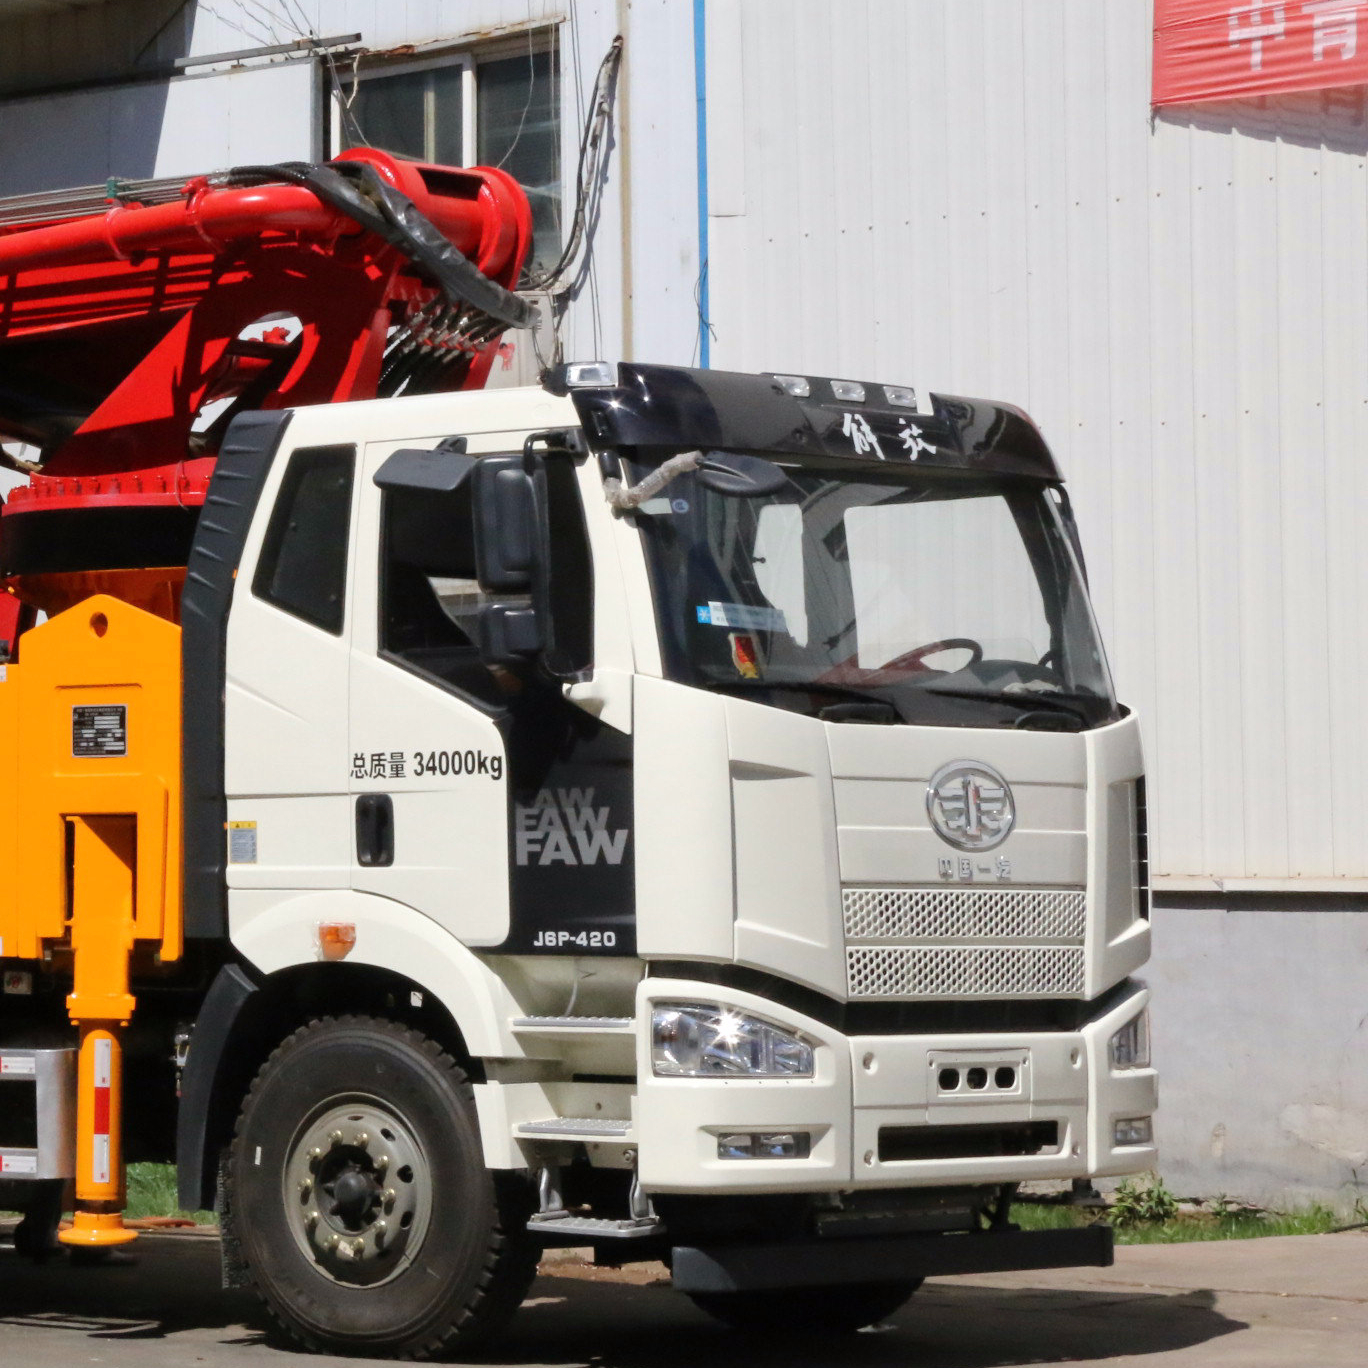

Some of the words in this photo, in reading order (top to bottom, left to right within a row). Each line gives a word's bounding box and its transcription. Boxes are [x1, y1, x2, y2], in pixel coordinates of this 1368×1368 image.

[842, 413, 937, 460] 解放
[350, 752, 407, 779] 总质量
[413, 750, 503, 780] 34000kg
[516, 829, 629, 866] FAW
[533, 931, 617, 947] J6P-420
